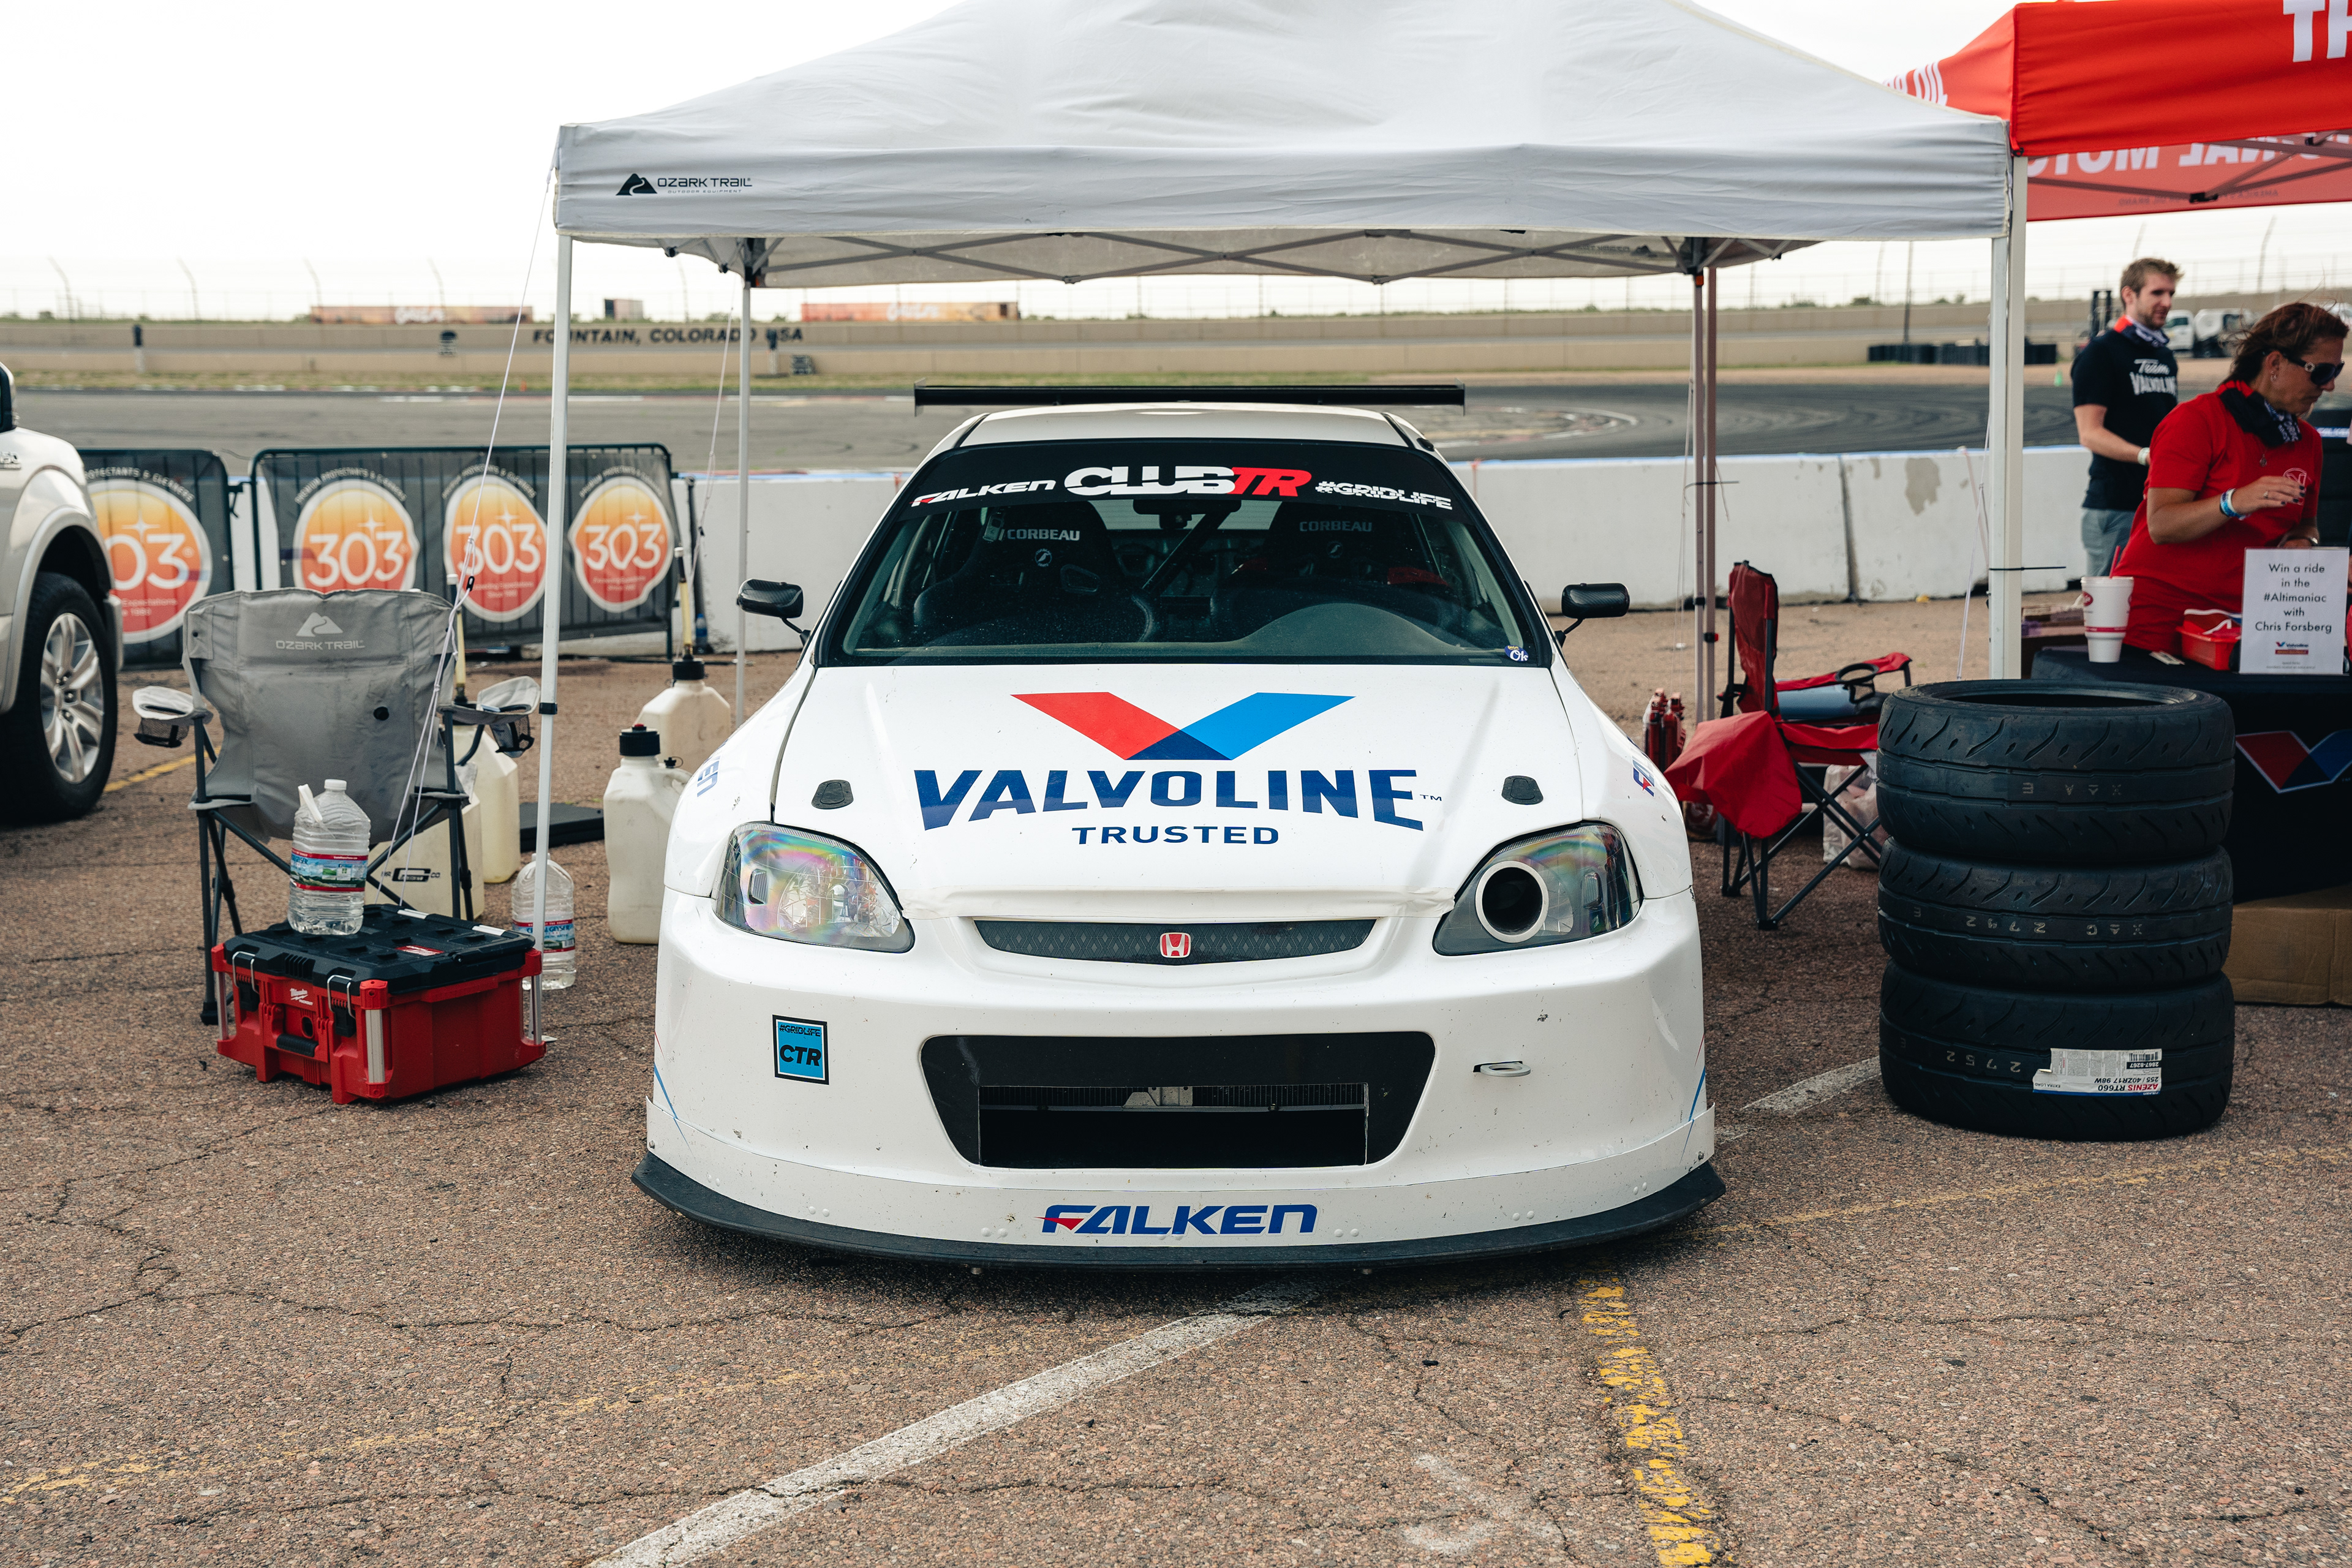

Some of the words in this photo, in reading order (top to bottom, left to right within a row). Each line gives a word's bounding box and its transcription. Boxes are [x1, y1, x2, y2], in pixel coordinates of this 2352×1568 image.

[532, 328, 640, 345] FONTAIN,
[766, 328, 803, 342] SA
[2133, 358, 2170, 374] Team
[2129, 372, 2176, 396] VALVOLIN
[910, 480, 1057, 507] FALKEN
[1315, 481, 1453, 511] #GRIDLIFE
[1007, 529, 1080, 541] CORBEAU
[1299, 521, 1373, 532] CORBEAU
[456, 523, 541, 576] 303
[585, 523, 662, 571] 303
[104, 533, 190, 590] 03
[308, 530, 405, 587] 303
[2269, 564, 2290, 572] Win
[2304, 563, 2325, 573] ride
[2282, 578, 2290, 587] in
[2294, 578, 2310, 588] the
[2264, 592, 2327, 603] #Altimaniac
[2283, 606, 2305, 616] with
[2255, 621, 2281, 631] Chris
[2285, 621, 2332, 635] Forsberg
[1510, 650, 1528, 662] Ok
[913, 769, 1423, 832] VALVOLINE
[1072, 826, 1279, 845] TRUSTED
[779, 1024, 821, 1037] #GRIDLIFE
[780, 1044, 821, 1066] CTR
[1033, 1204, 1317, 1235] FALKEN
